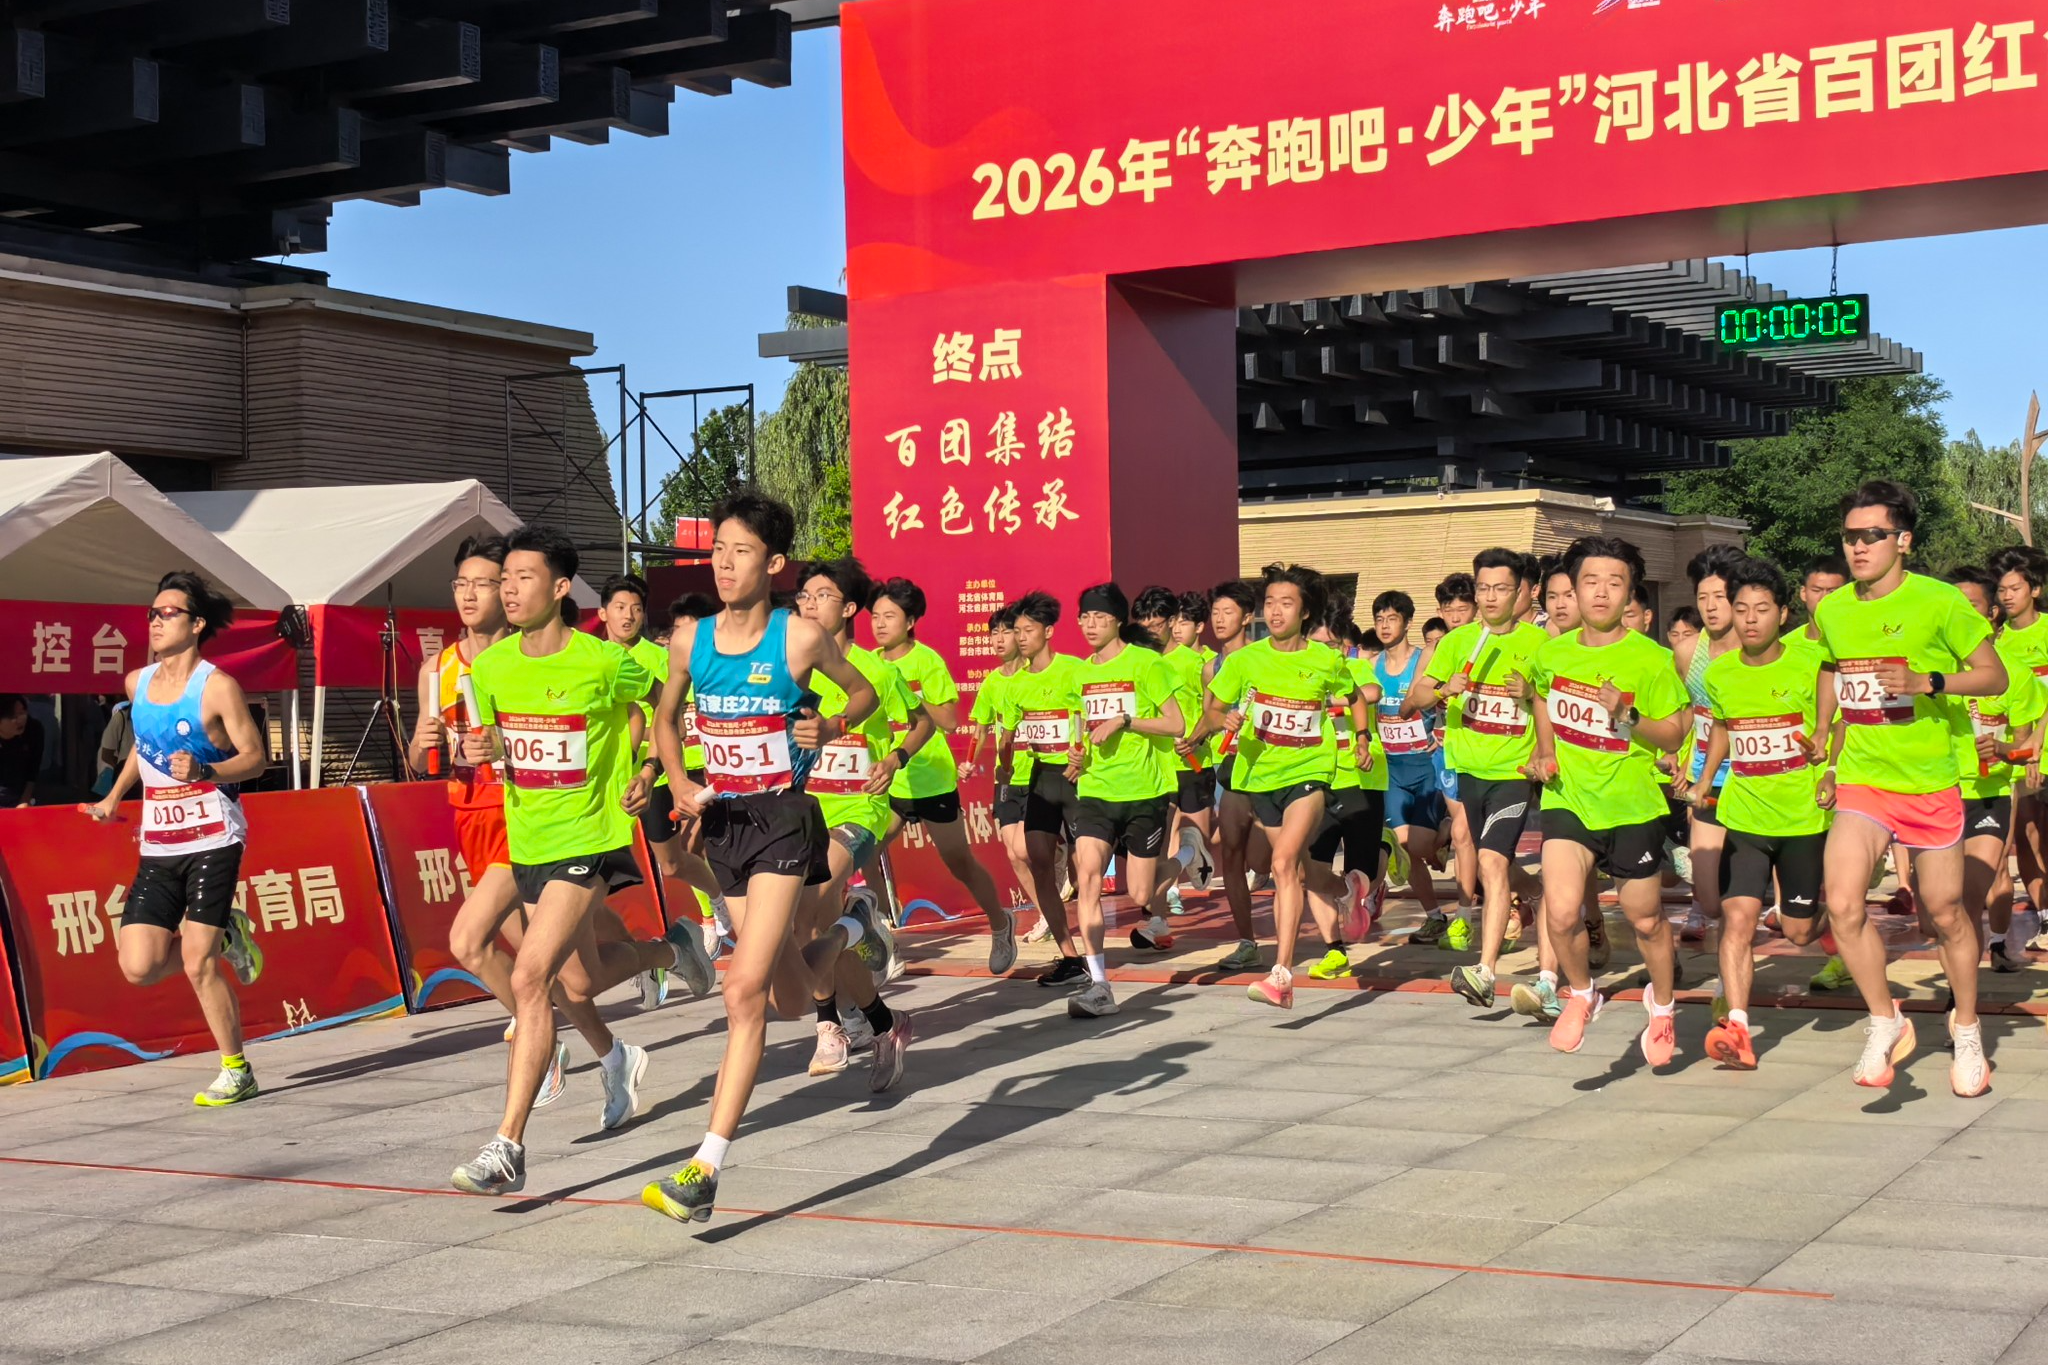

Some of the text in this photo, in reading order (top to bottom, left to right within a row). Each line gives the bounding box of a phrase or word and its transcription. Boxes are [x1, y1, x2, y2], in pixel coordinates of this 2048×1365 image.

[972, 20, 2048, 220] 2026年“奔跑吧·少年”河北省百团红
[1721, 300, 1859, 344] 00:00:02
[932, 329, 1022, 384] 终点
[884, 406, 1076, 467] 百团集结
[883, 478, 1080, 540] 红色传承
[965, 579, 996, 590] 主办单位
[958, 592, 1005, 603] 河北省体育局
[32, 621, 161, 675] 控台
[959, 636, 993, 646] 邢台市体
[1840, 680, 1899, 703] 002-
[1085, 698, 1126, 715] 017-1
[1468, 698, 1520, 720] 014-1
[1557, 699, 1619, 733] 004-1
[1026, 724, 1061, 740] 029-1
[1262, 710, 1313, 733] 015-1
[1384, 726, 1418, 740] 037-1
[503, 736, 572, 763] 006-1
[703, 741, 775, 769] 005-1
[1735, 733, 1795, 756] 003-1
[153, 800, 210, 825] 010-1
